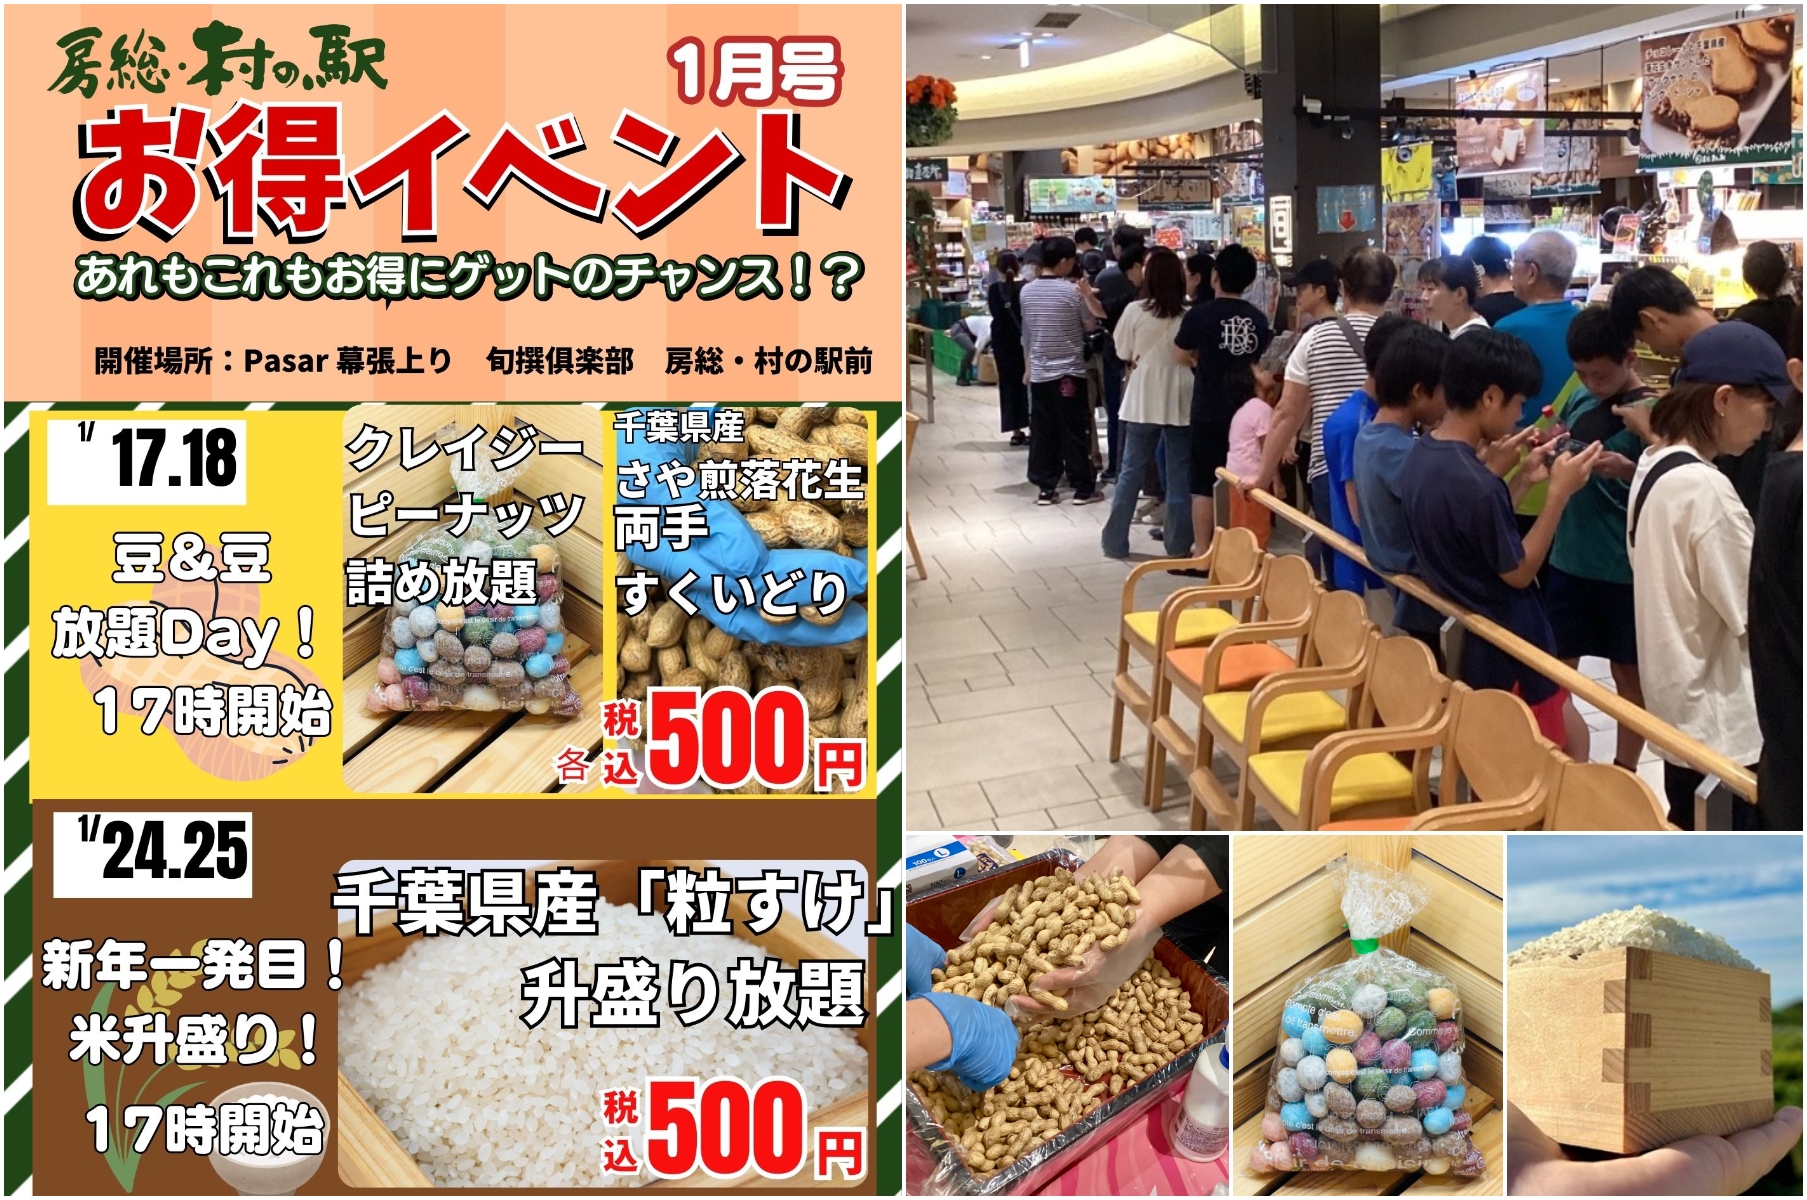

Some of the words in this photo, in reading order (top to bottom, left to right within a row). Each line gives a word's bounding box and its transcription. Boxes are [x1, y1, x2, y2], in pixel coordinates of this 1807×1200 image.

[47, 24, 388, 97] 房総・村の駅
[669, 36, 843, 105] 1月号
[76, 101, 852, 243] お得イベント
[74, 250, 864, 302] あれもこれもお得にゲットのチャンス！？
[336, 345, 453, 376] 幕張上り
[664, 345, 874, 376] 房総・村の駅前
[345, 423, 585, 472] クレイジー
[613, 410, 745, 445] 千葉県産
[112, 428, 238, 489] 17.18
[616, 458, 866, 502] さや煎落花生
[349, 490, 587, 538] ピーナッツ
[614, 504, 710, 552] 両手
[346, 557, 539, 608] 詰め放題
[614, 569, 848, 620] すくいどり
[556, 746, 591, 784] 各
[648, 688, 806, 790] 500
[815, 740, 865, 789] 円
[103, 820, 249, 880] 24.25
[331, 869, 893, 936] 千葉県産「粒すけ」
[41, 938, 346, 991] 新年一発目！
[521, 959, 866, 1028] 升盛り放題
[68, 1013, 316, 1066] 米升盛り！
[648, 1078, 806, 1179] 500
[815, 1130, 865, 1177] 円
